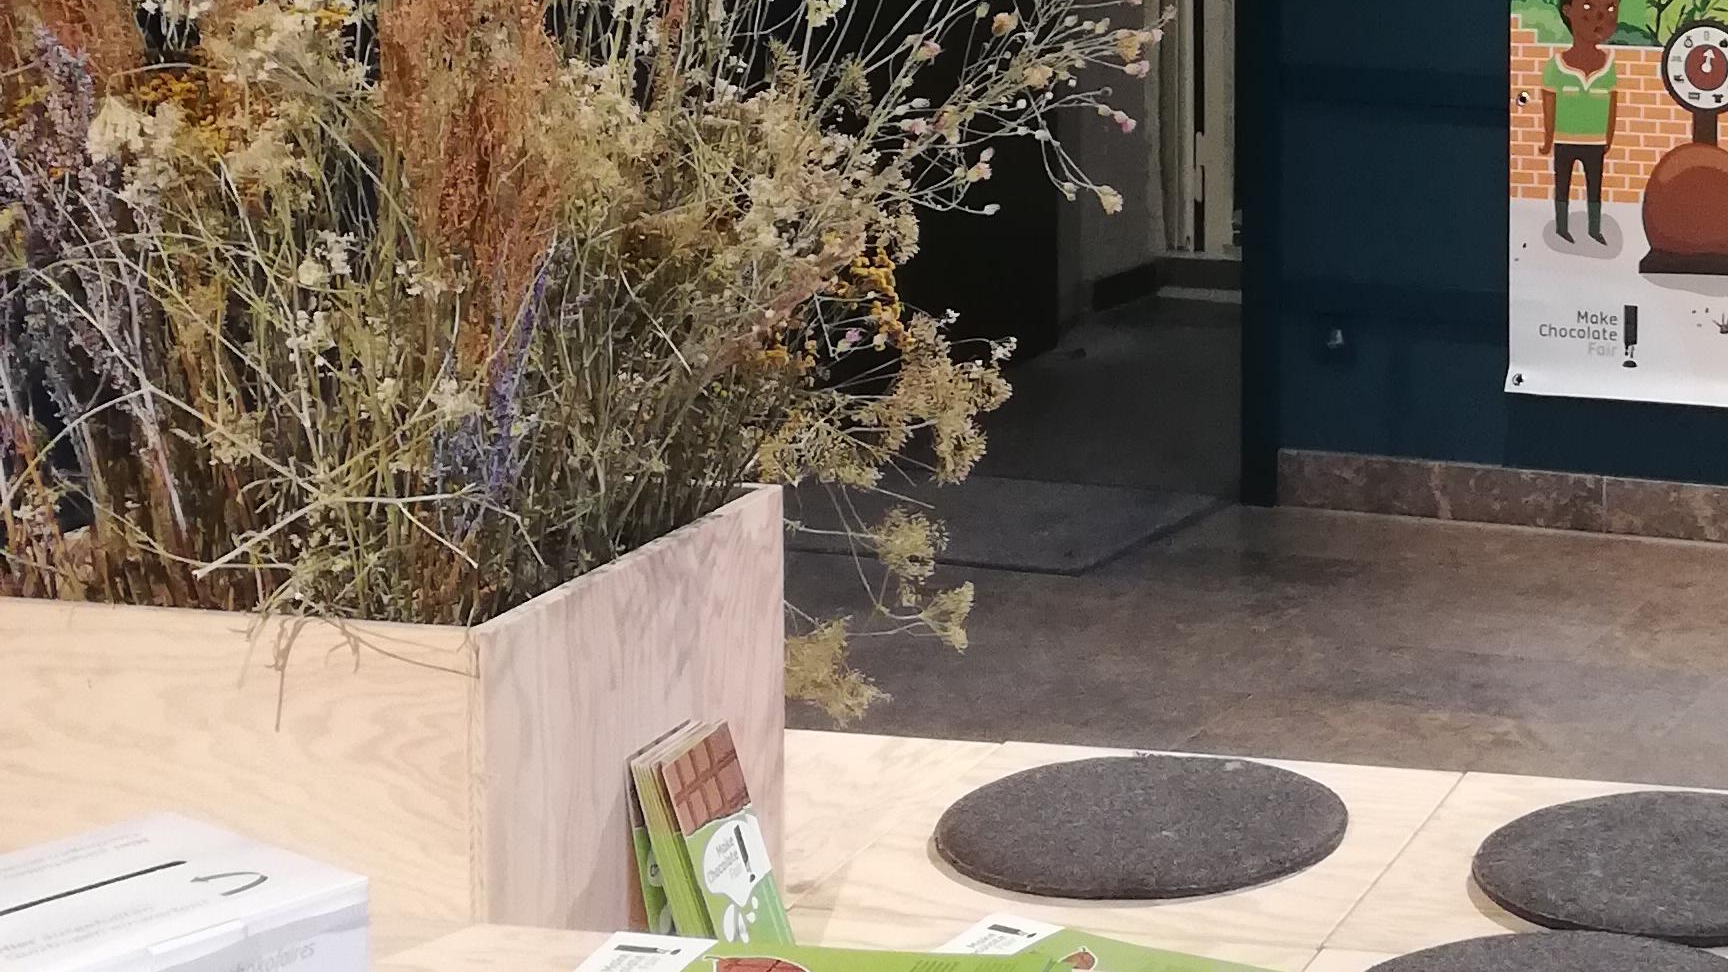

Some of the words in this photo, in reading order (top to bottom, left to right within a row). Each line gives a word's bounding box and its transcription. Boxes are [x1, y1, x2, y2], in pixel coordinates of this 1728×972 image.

[1577, 310, 1618, 326] Make
[1539, 323, 1618, 342] Chocolate
[1588, 343, 1618, 359] Fair
